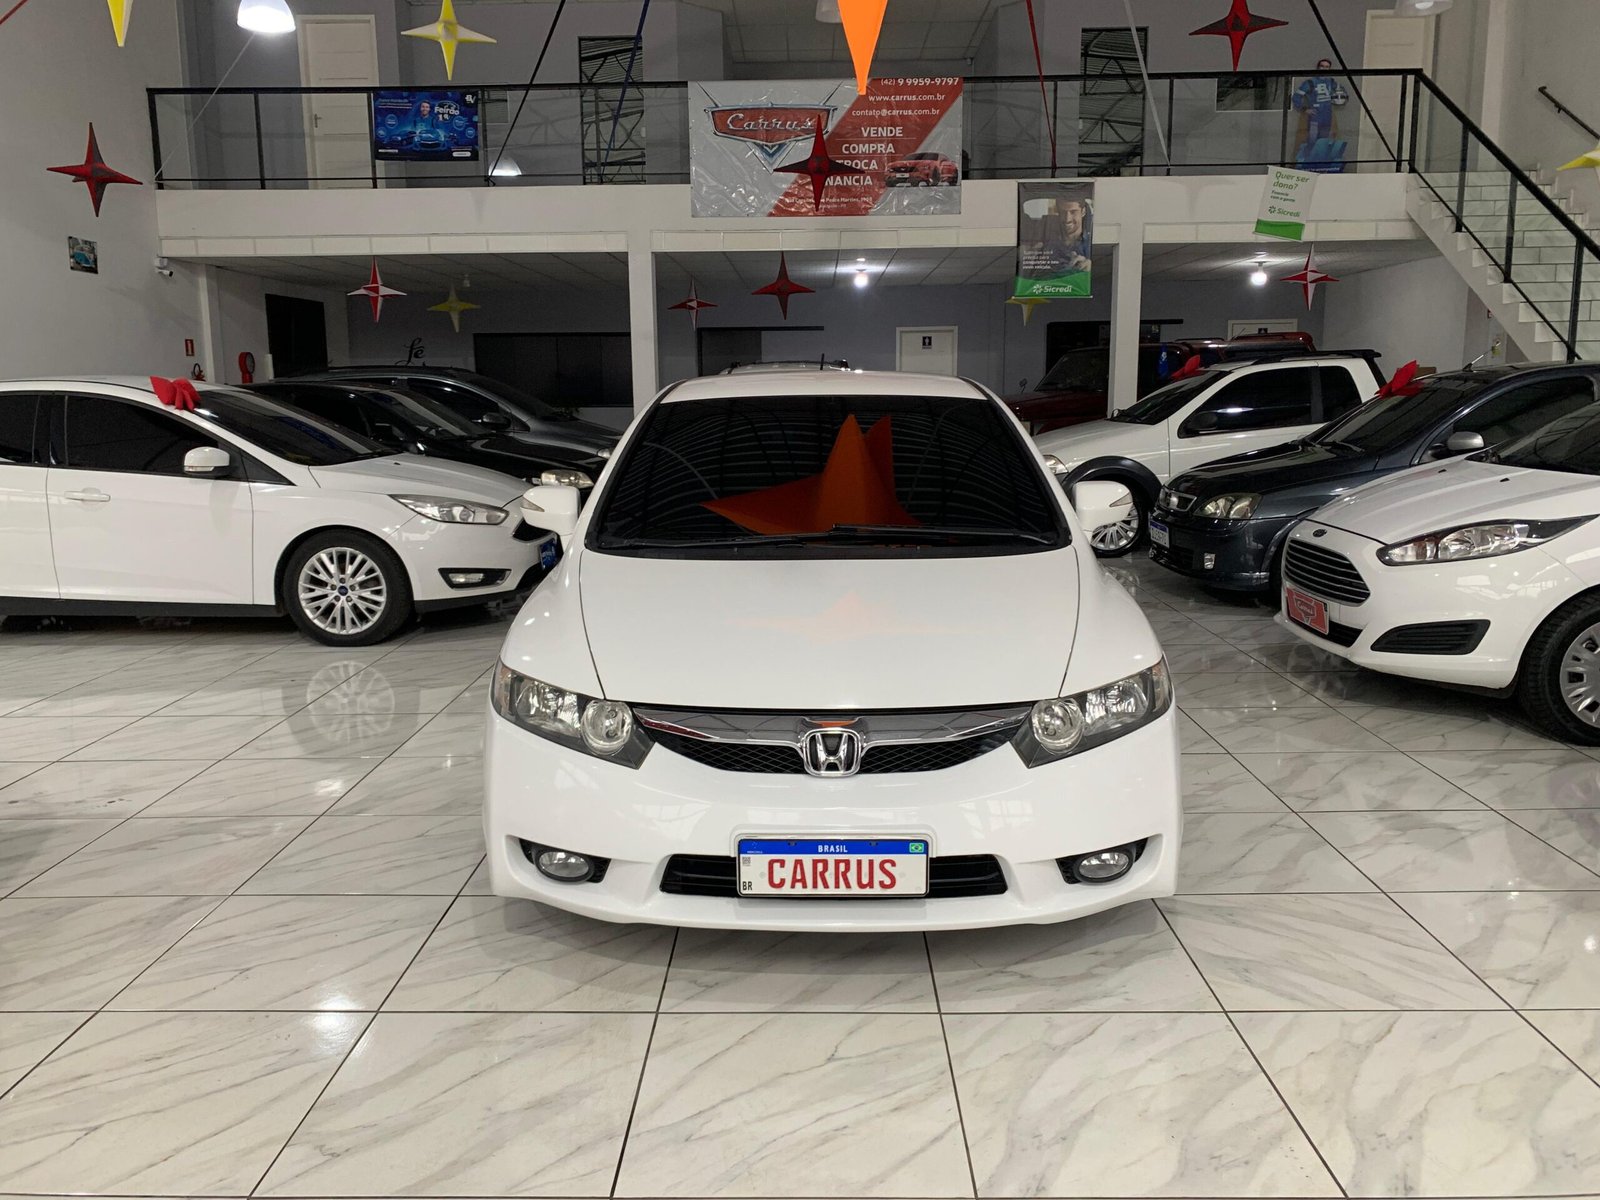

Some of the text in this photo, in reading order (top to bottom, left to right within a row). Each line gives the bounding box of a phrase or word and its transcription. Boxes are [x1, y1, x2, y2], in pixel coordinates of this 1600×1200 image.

[880, 77, 960, 86] (42) 9 9959-9797
[868, 93, 946, 102] www.carrus.com.br
[851, 108, 940, 117] contato@carrus.com.br
[727, 113, 816, 131] Carrus
[861, 126, 904, 137] VENDE
[841, 143, 895, 154] COMPRA
[824, 175, 873, 186] NANCIA
[1275, 171, 1310, 183] Quer ser
[1273, 180, 1299, 190] dono?
[1277, 207, 1301, 218] Sicredi
[1043, 285, 1073, 293] Sicredi
[817, 844, 848, 853] BRASIL
[767, 858, 897, 890] CARRUS
[742, 881, 753, 891] BR
